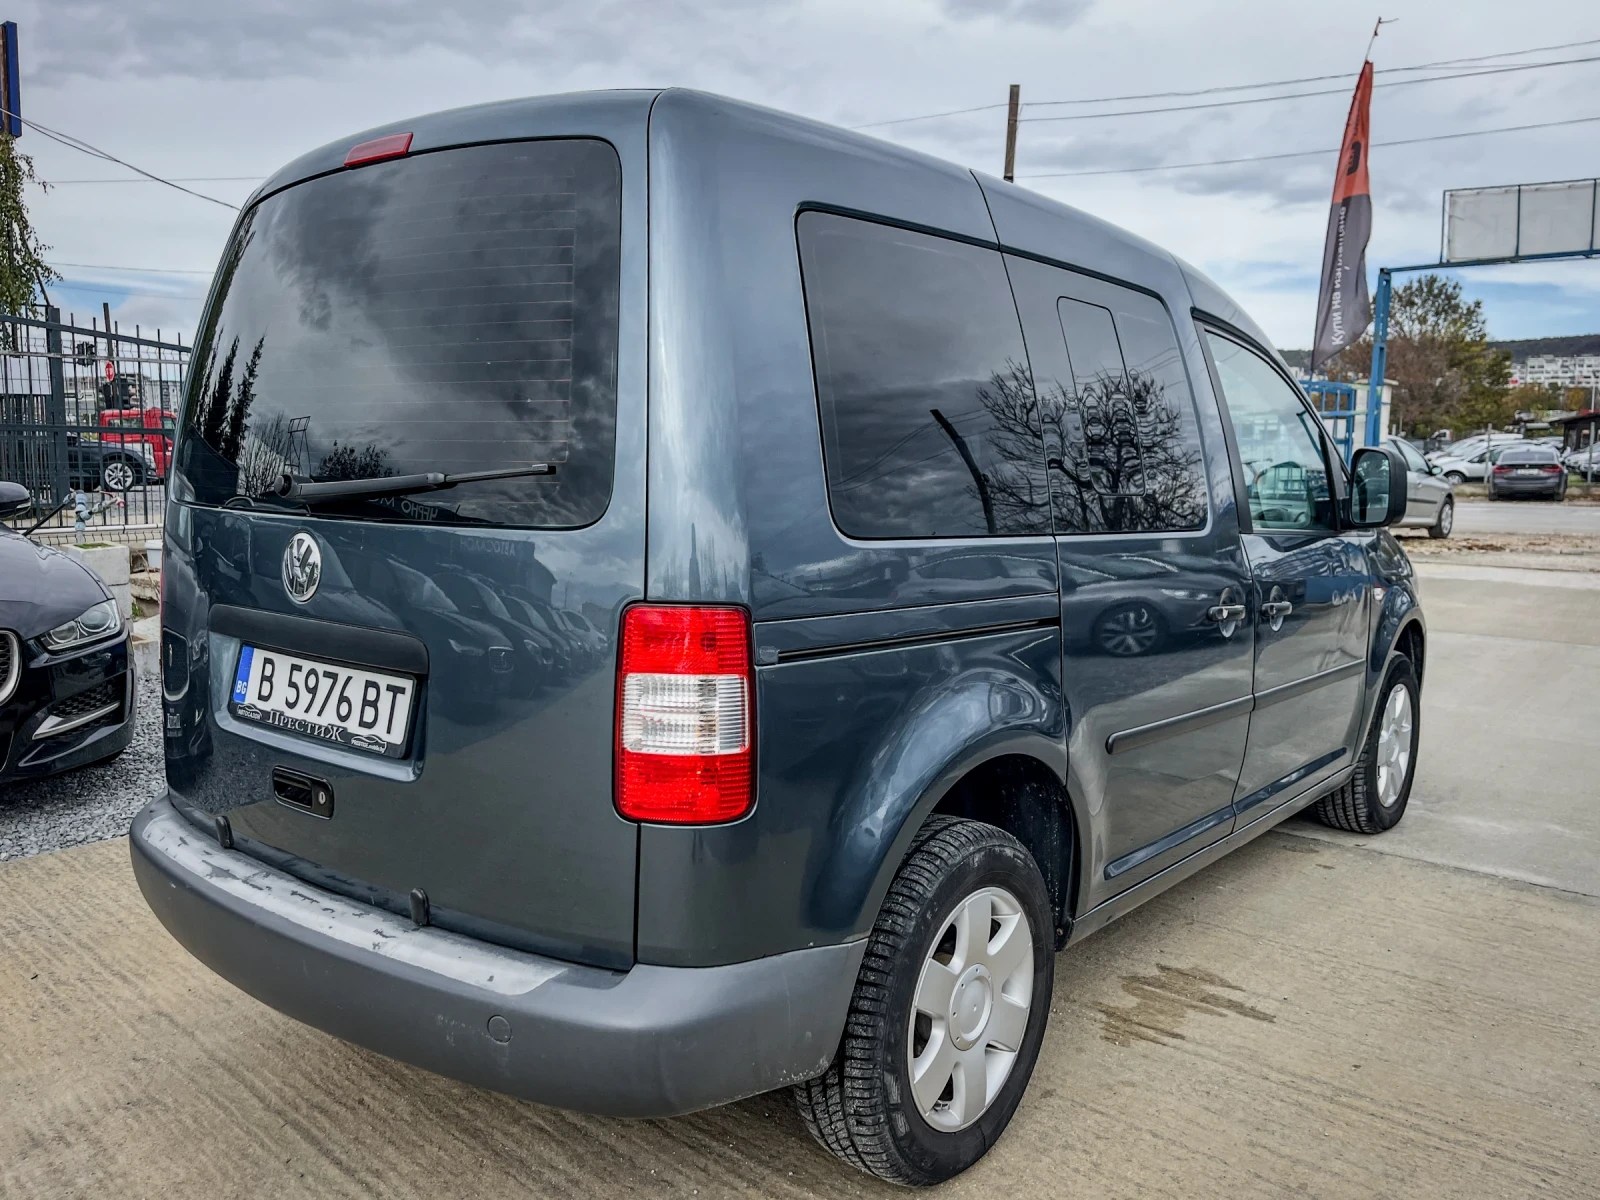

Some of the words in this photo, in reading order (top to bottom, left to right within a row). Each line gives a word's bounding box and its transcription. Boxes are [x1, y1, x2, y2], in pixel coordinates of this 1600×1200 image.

[1332, 292, 1341, 309] на
[1332, 312, 1345, 345] Купи
[236, 680, 247, 695] BG
[257, 656, 275, 702] B
[285, 663, 353, 723] 5976
[358, 679, 406, 735] BT
[267, 710, 345, 743] ПРЕСТИЖ
